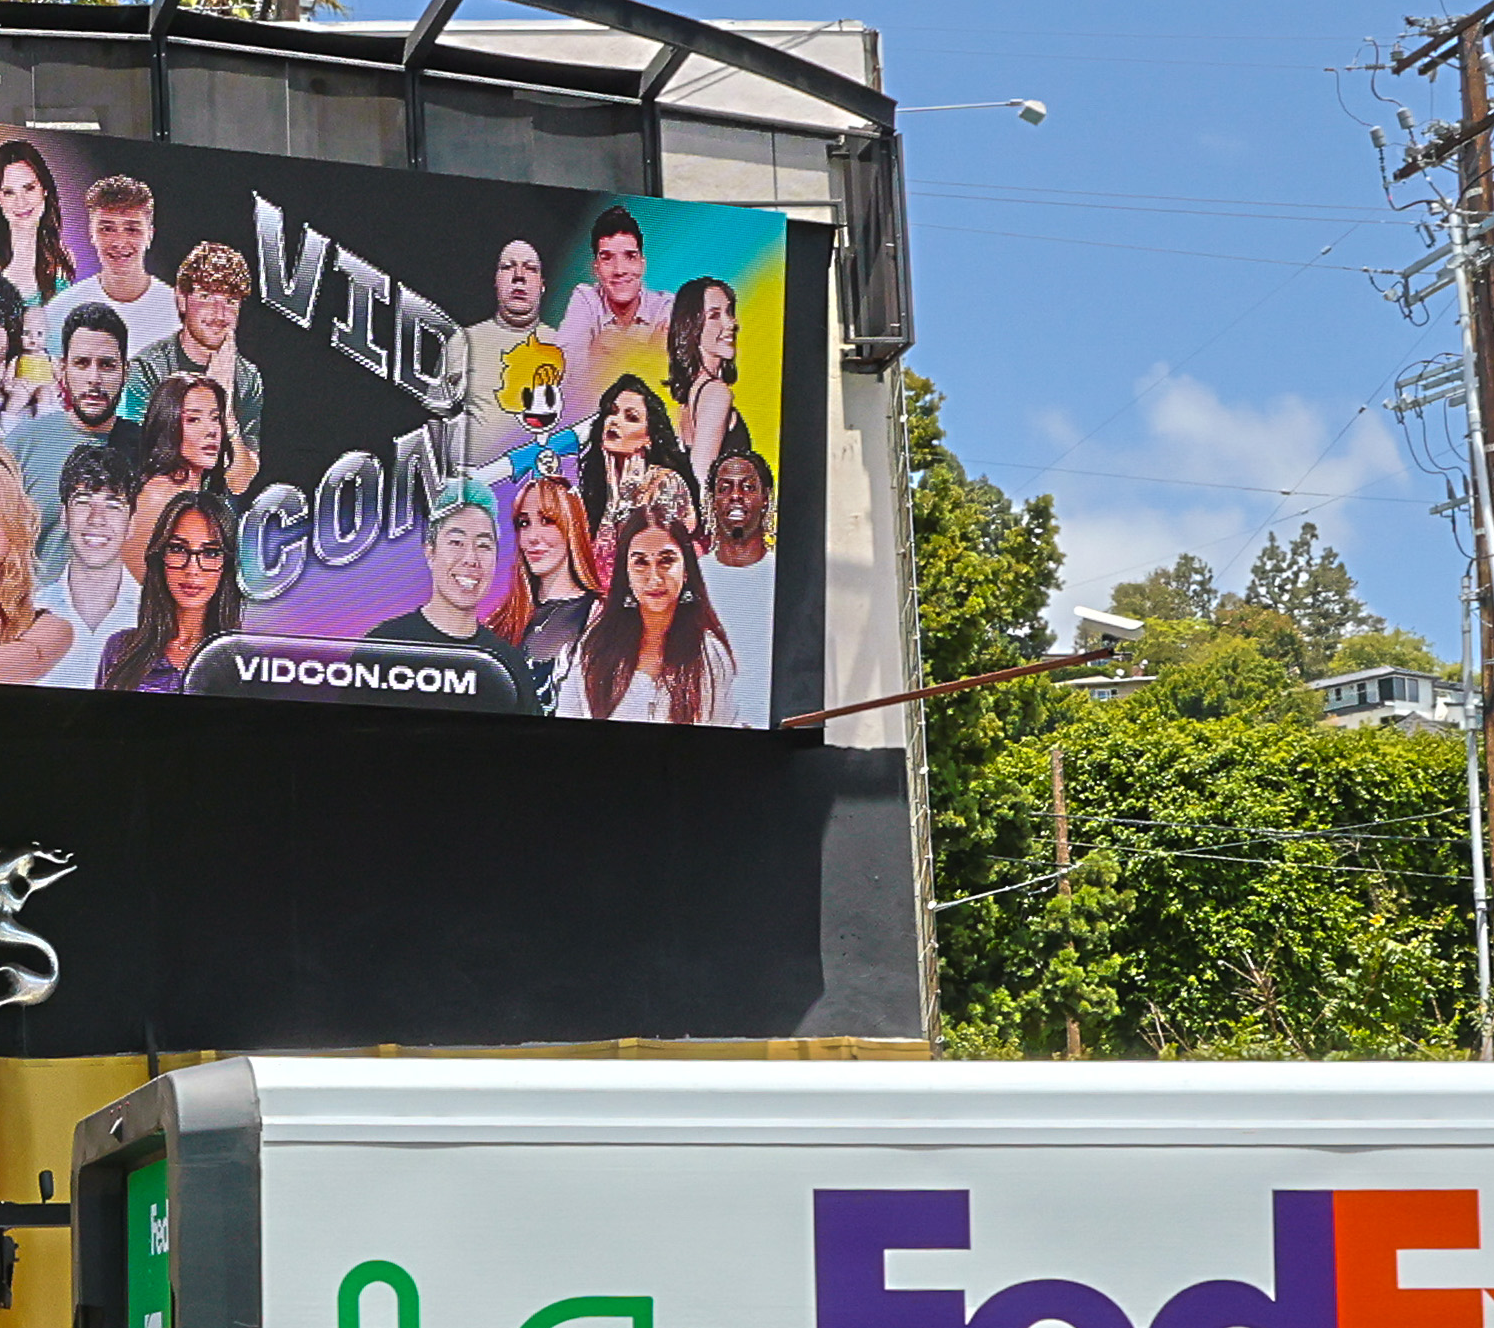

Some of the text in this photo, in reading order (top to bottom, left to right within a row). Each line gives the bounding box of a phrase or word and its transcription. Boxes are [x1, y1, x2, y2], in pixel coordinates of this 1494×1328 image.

[252, 190, 471, 417] VID
[239, 417, 472, 602] CON
[235, 656, 478, 697] VIDCON.COM
